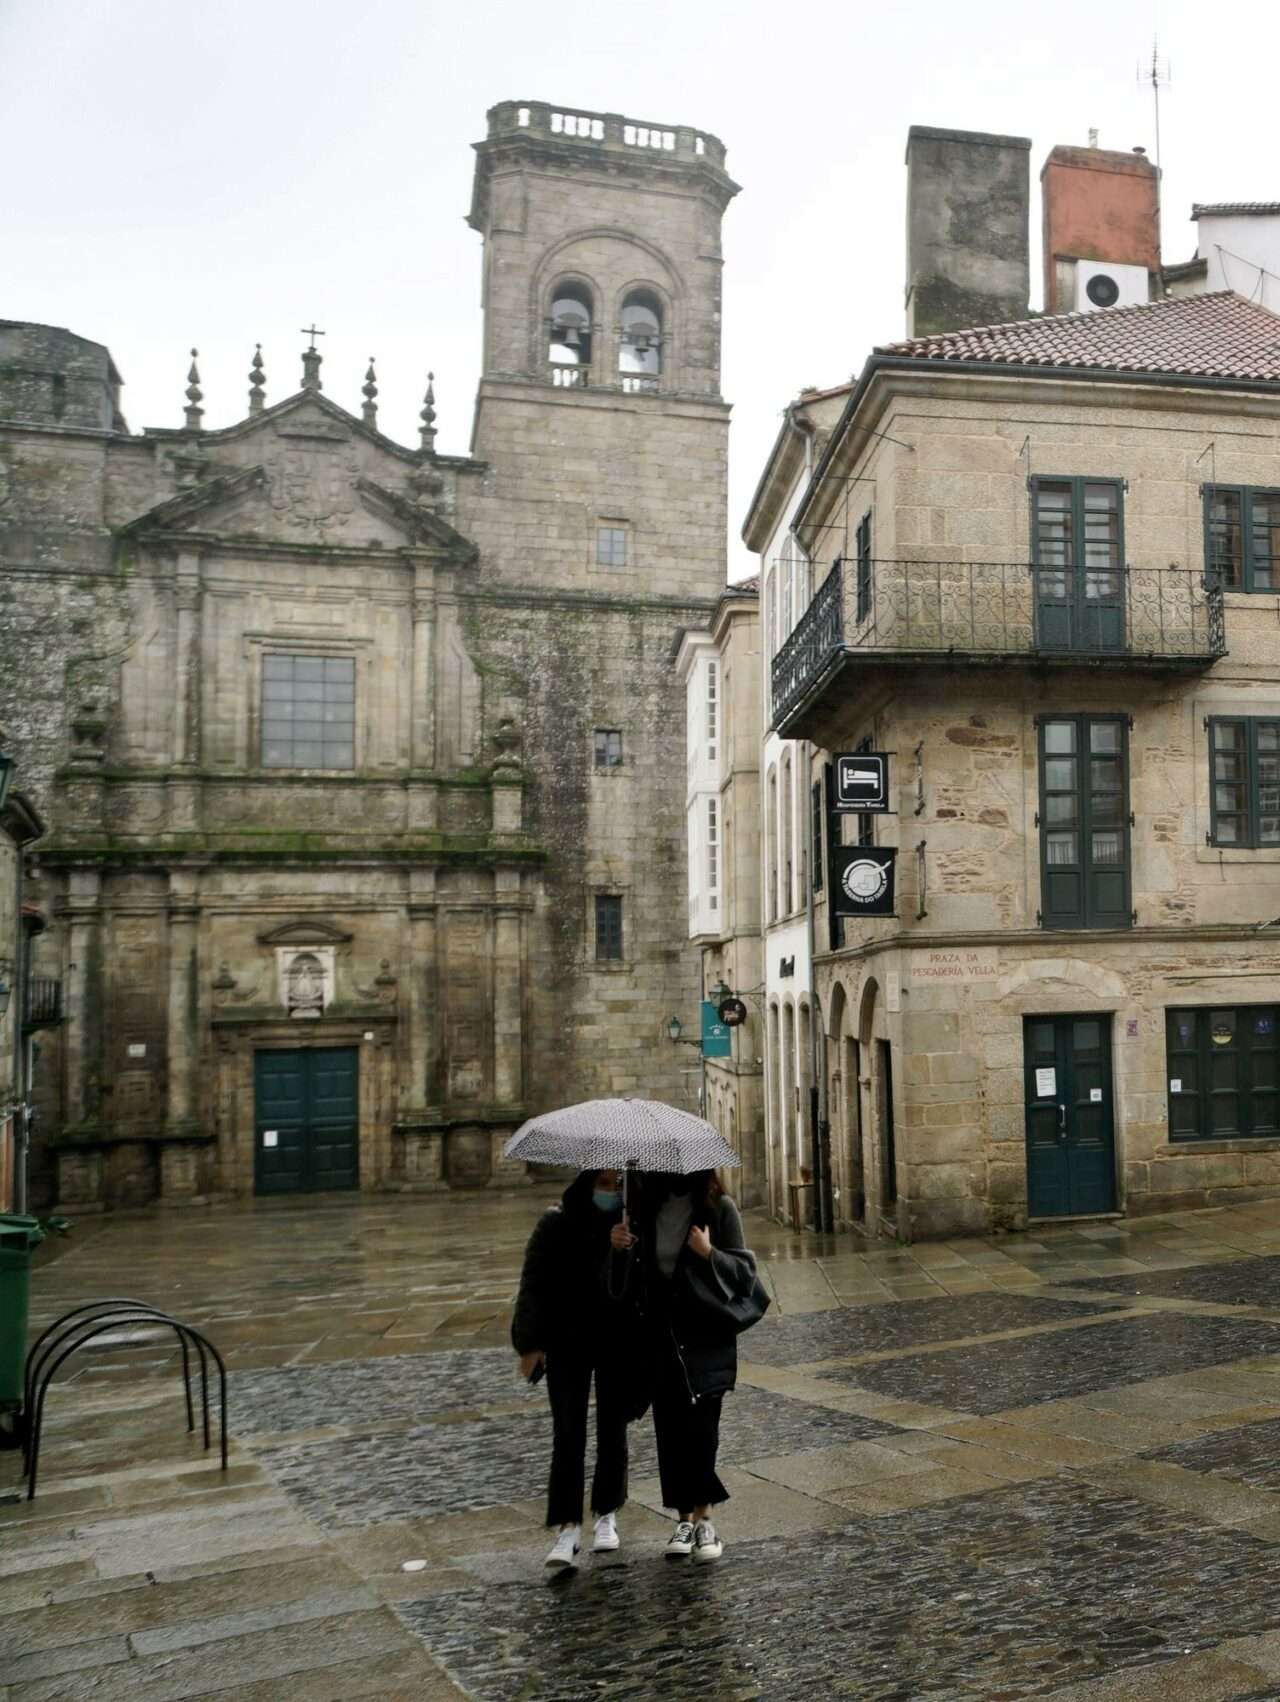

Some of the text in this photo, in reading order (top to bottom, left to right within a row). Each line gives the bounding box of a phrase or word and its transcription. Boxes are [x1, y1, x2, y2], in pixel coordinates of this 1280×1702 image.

[928, 953, 979, 962] PRAZA DA
[967, 965, 996, 976] VELLA
